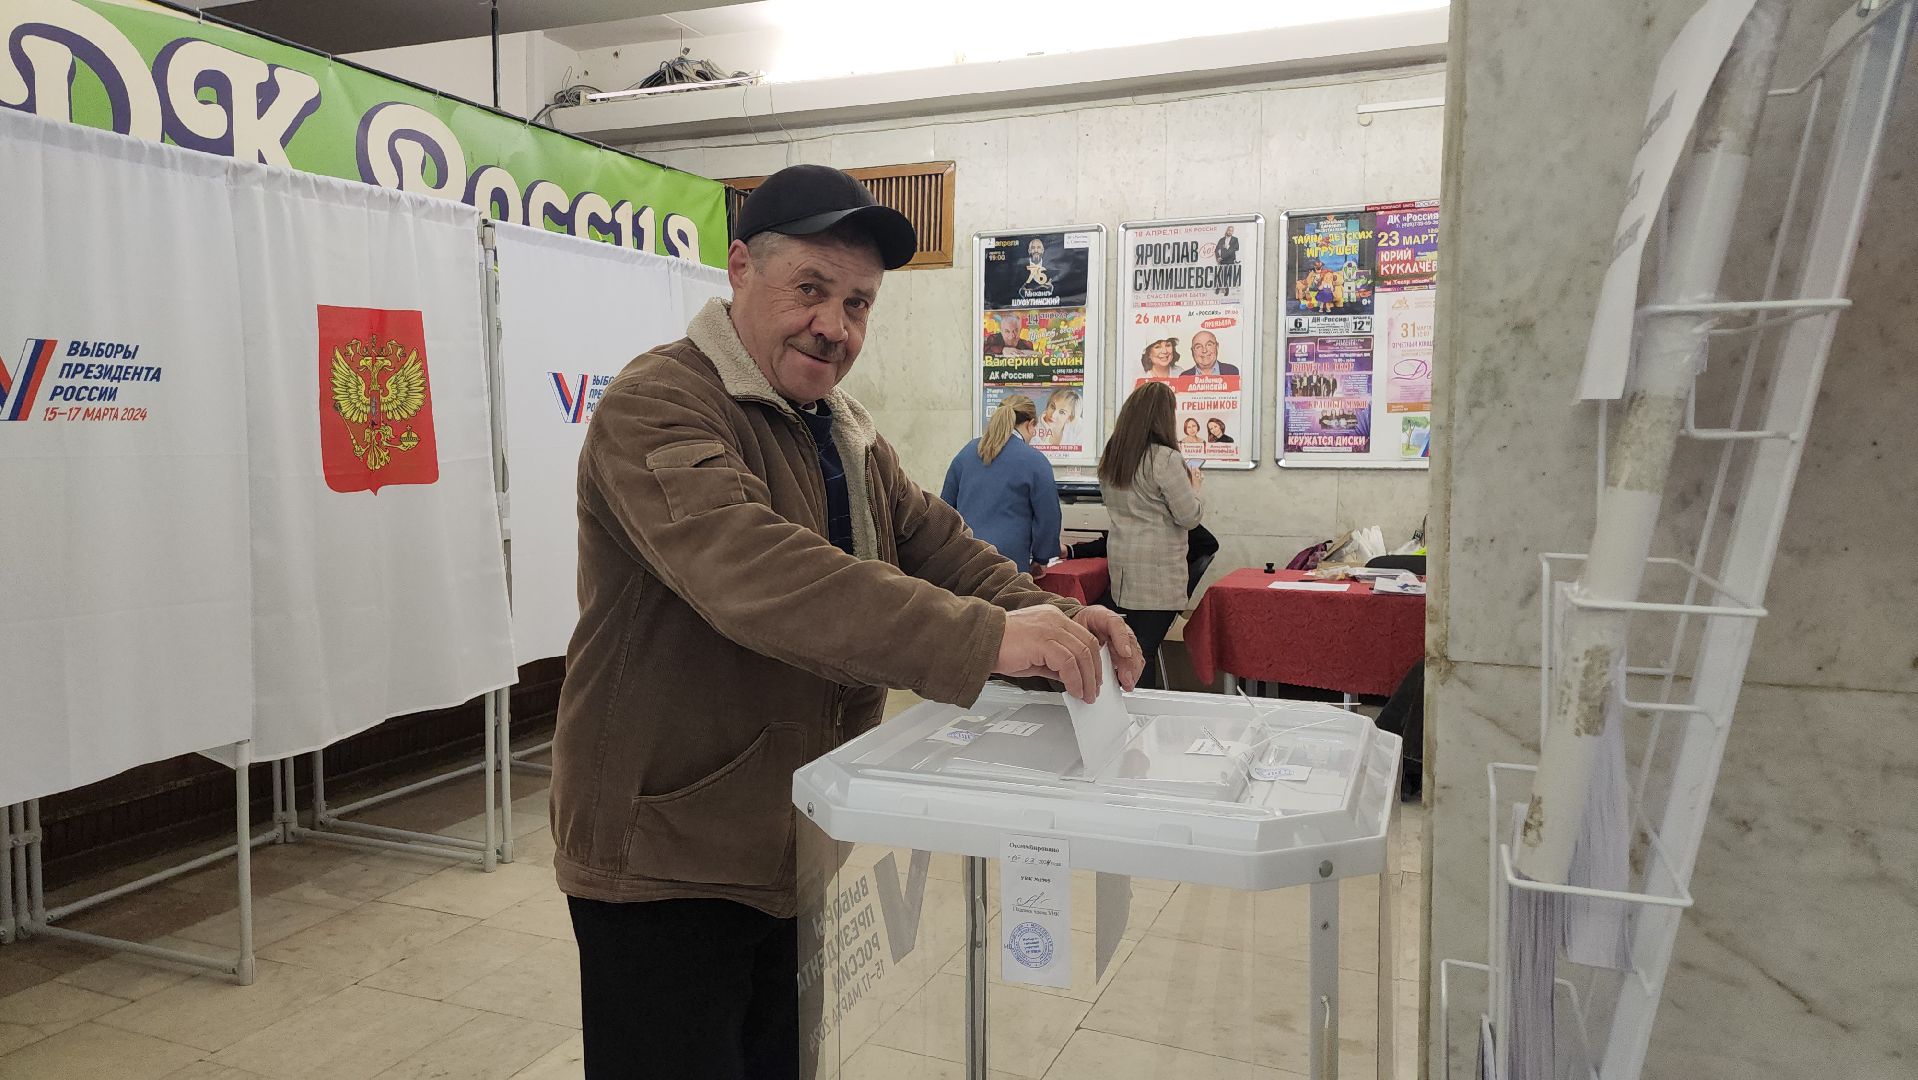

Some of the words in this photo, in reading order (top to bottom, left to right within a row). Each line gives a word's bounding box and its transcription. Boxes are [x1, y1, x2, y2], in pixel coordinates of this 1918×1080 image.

[1387, 214, 1401, 226] ДК
[1145, 228, 1179, 237] АПРЕЛЯ
[1292, 233, 1323, 245] ТАЙНА
[1328, 230, 1373, 242] ДЕТСКИХ
[1377, 230, 1400, 247] 23
[1135, 241, 1199, 265] ЯРОСЛАВ
[1306, 244, 1359, 258] ИГРУШЕК
[1380, 247, 1412, 262] ЮРИЙ
[1133, 260, 1242, 292] СУМИШЕВСКИЙ
[1135, 313, 1150, 325] 26
[1153, 314, 1182, 324] МАРТА
[1294, 318, 1303, 329] 6
[1401, 321, 1416, 338] 31
[66, 340, 140, 360] ВЫБОРЫ
[1295, 344, 1308, 354] 20
[985, 354, 1039, 370] Валерий
[58, 362, 162, 383] ПРЕЗИДЕНТА
[48, 385, 118, 402] РОССИИ
[1181, 400, 1238, 411] ГРЕШНИКОВ
[82, 407, 119, 422] МАРТА
[121, 407, 148, 422] 2024
[1288, 435, 1334, 446] КРУЖАТСЯ
[1335, 435, 1366, 447] ДИСКИ
